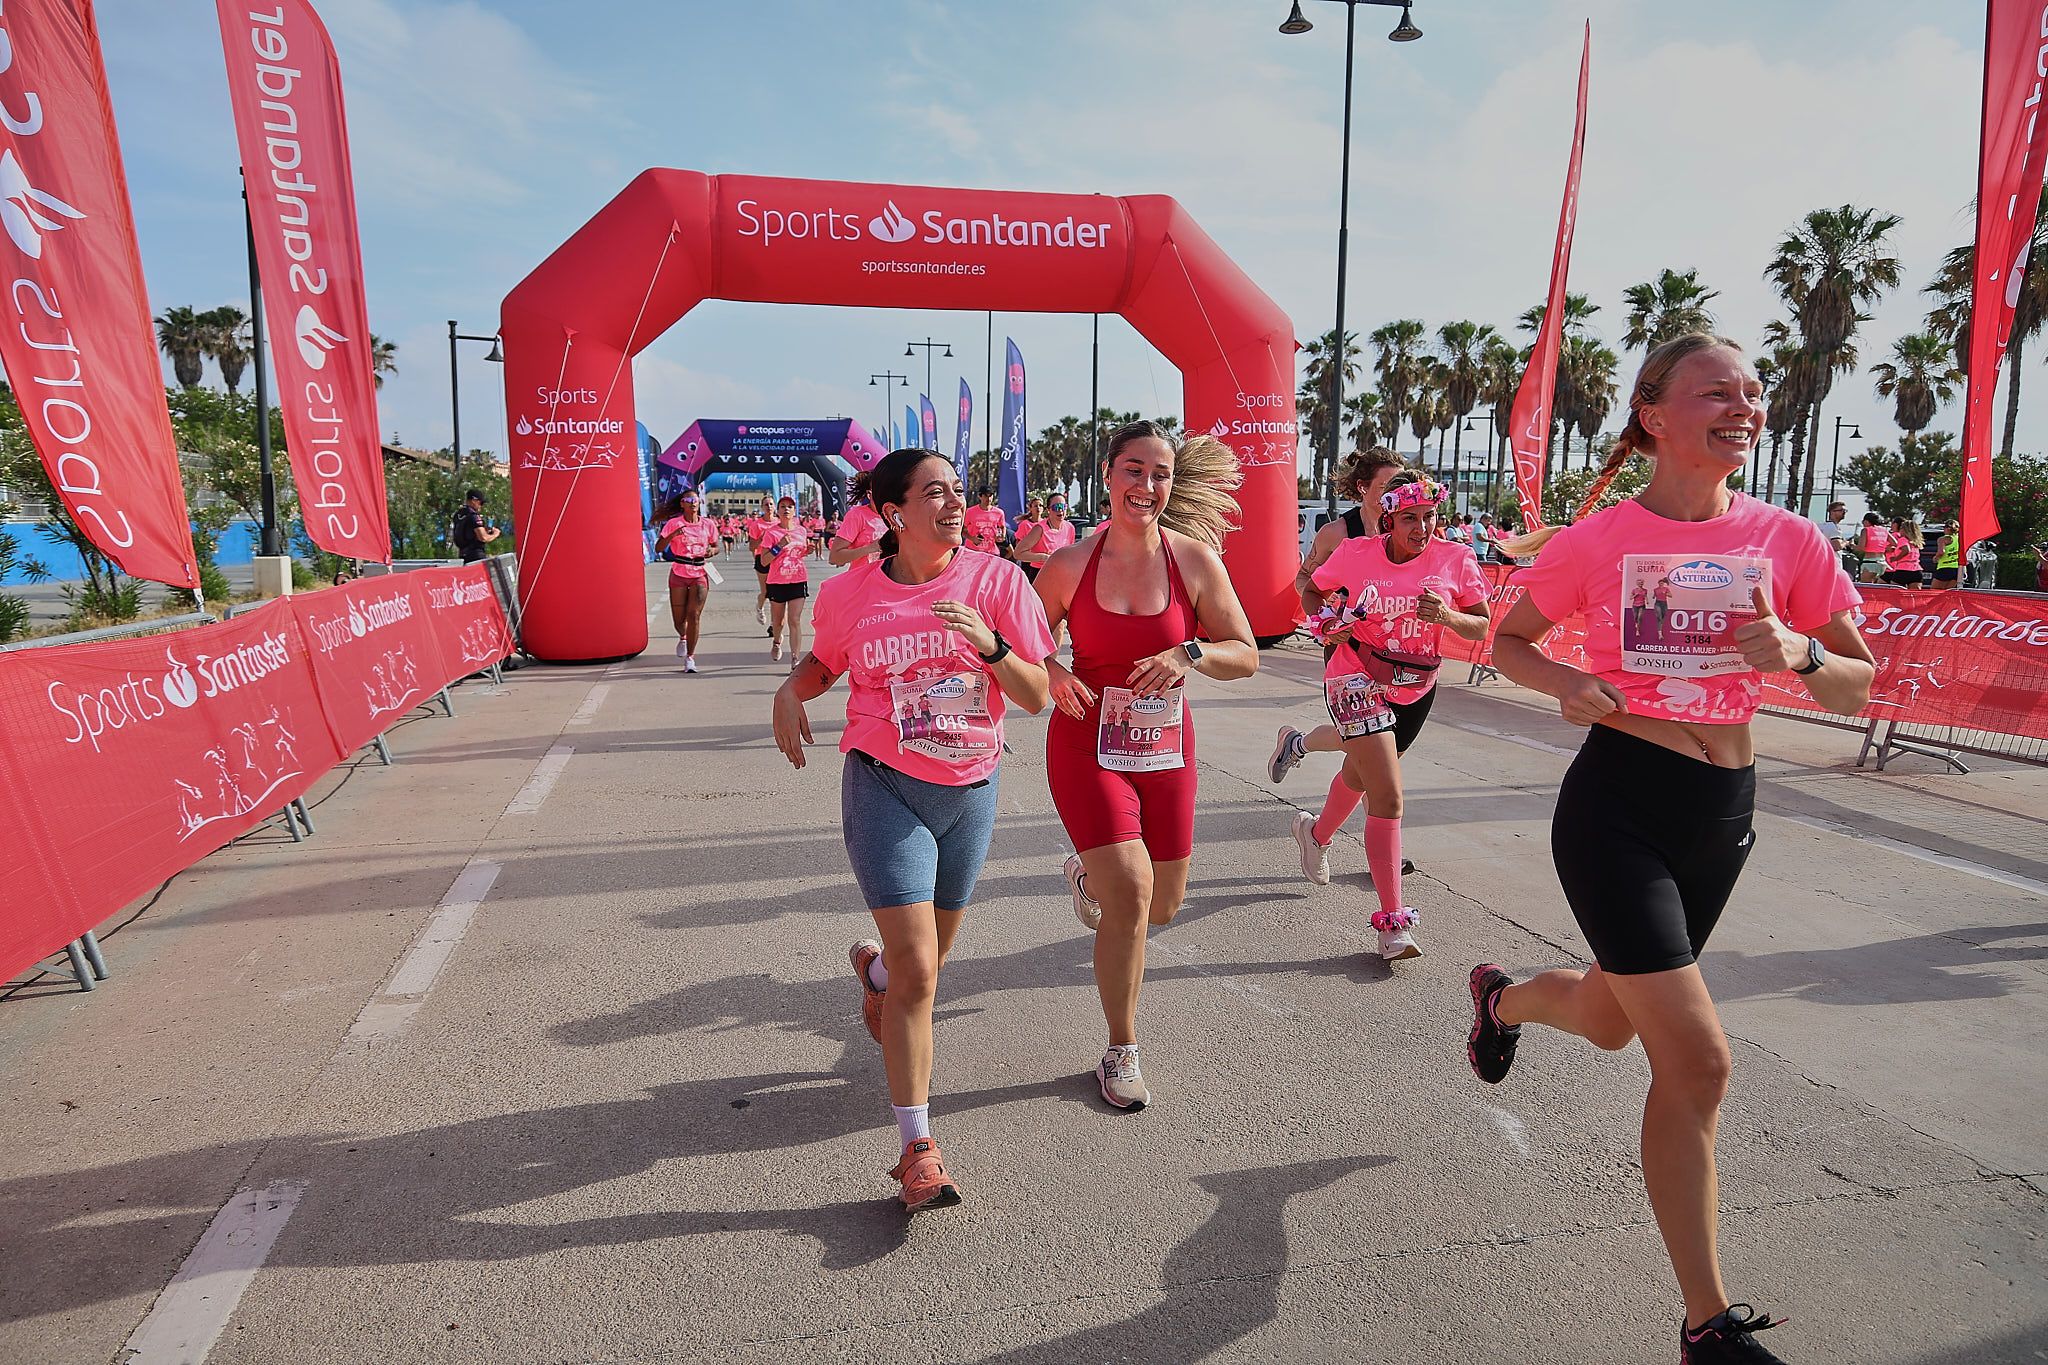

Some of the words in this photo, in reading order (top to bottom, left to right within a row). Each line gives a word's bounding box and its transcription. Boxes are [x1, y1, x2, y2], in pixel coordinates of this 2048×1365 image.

[736, 200, 861, 246] Sports
[922, 210, 1111, 248] Santander
[861, 258, 986, 275] sportssantander.es
[537, 386, 598, 408] Sports
[1236, 392, 1283, 411] Sports
[534, 417, 625, 434] Santander
[749, 427, 785, 436] octopus
[785, 427, 815, 437] energy
[718, 454, 800, 464] VOLVO
[1363, 579, 1393, 588] OYSHO
[1672, 571, 1729, 583] ASTURIANA
[1489, 583, 1525, 604] orts
[857, 611, 897, 629] OYSHO
[1670, 610, 1728, 632] 016
[1864, 607, 2048, 647] Santande
[309, 612, 353, 661] Sports
[1684, 635, 1712, 645] 3184
[863, 630, 959, 670] CARRERA
[1635, 644, 1669, 653] CARRERA
[1669, 645, 1680, 653] DE
[1681, 646, 1691, 654] LA
[1692, 646, 1717, 654] MUJER
[1637, 657, 1683, 670] OYSHO
[1710, 660, 1743, 670] Santander
[48, 672, 165, 753] Sports
[198, 631, 292, 699] Santander
[1133, 700, 1166, 711] ASTURIANA
[935, 714, 970, 730] 016
[1130, 727, 1162, 742] 016
[1107, 758, 1136, 767] OYSHO
